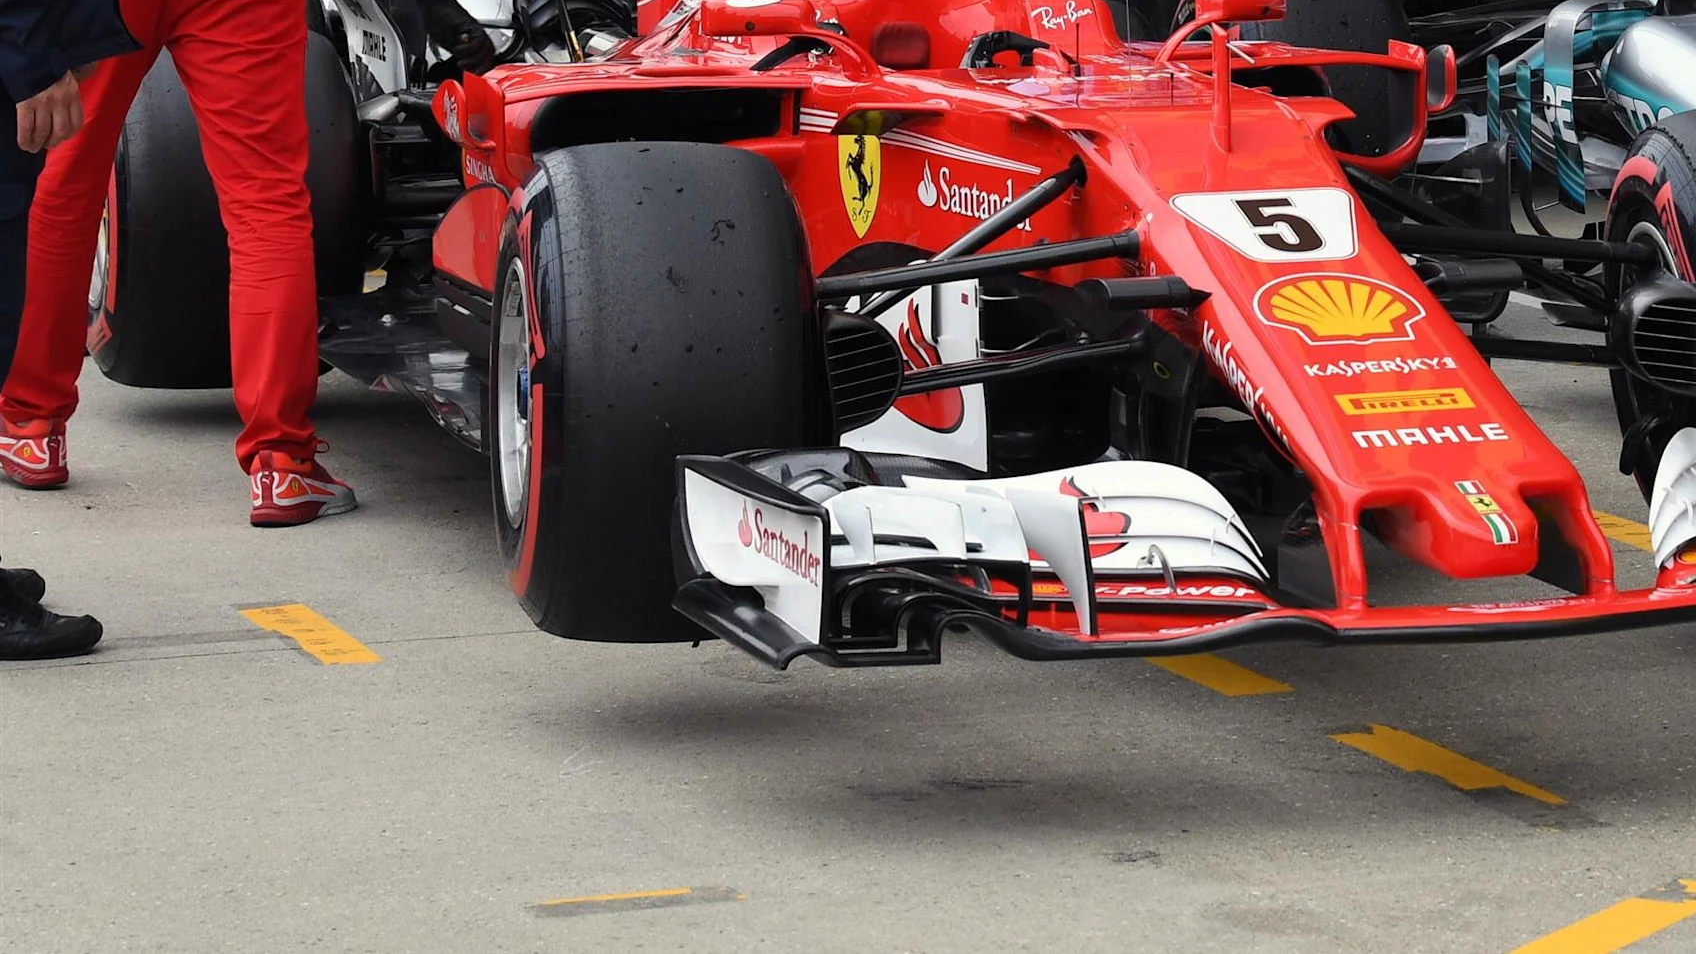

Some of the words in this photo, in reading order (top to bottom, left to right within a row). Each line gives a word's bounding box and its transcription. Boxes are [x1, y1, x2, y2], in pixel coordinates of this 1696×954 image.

[1030, 0, 1093, 30] Ray-Ban
[466, 154, 497, 184] SINGHA
[1234, 197, 1325, 252] 5
[1303, 356, 1440, 378] KASPERSKY
[1348, 392, 1462, 411] PIRELLI
[1351, 422, 1510, 449] MAHLE
[754, 507, 821, 588] Santander
